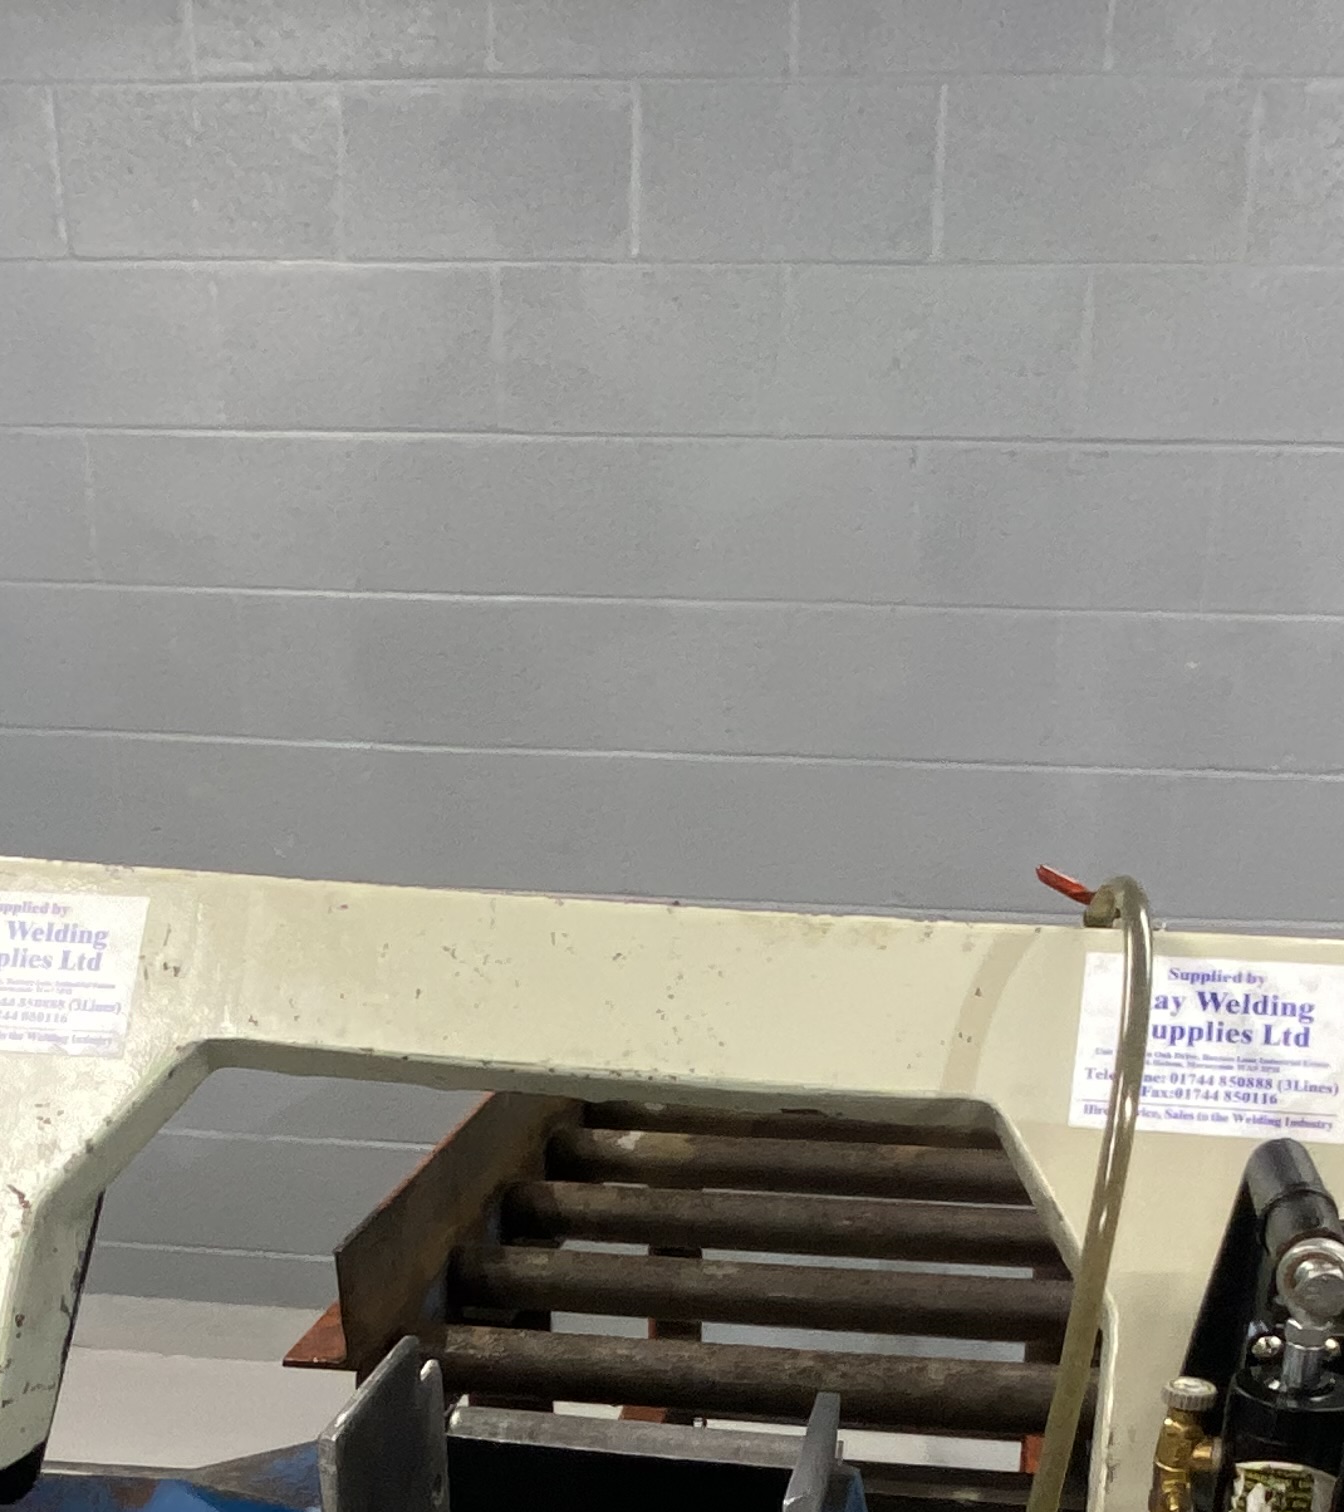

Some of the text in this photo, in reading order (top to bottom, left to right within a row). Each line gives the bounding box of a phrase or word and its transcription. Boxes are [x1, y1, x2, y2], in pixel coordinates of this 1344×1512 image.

[51, 903, 70, 917] by
[6, 920, 108, 949] Welding
[60, 949, 102, 971] Ltd
[1168, 968, 1267, 988] Supplied by
[1153, 990, 1315, 1024] ay Welding
[1152, 1021, 1310, 1047] upplies Ltd
[1170, 1072, 1214, 1086] 01744
[1219, 1076, 1273, 1089] 850888
[1277, 1079, 1339, 1096] (3Lines)
[1224, 1091, 1278, 1104] 850116
[1164, 1109, 1194, 1120] Sales
[1211, 1112, 1229, 1122] the
[1233, 1113, 1282, 1128] Welding
